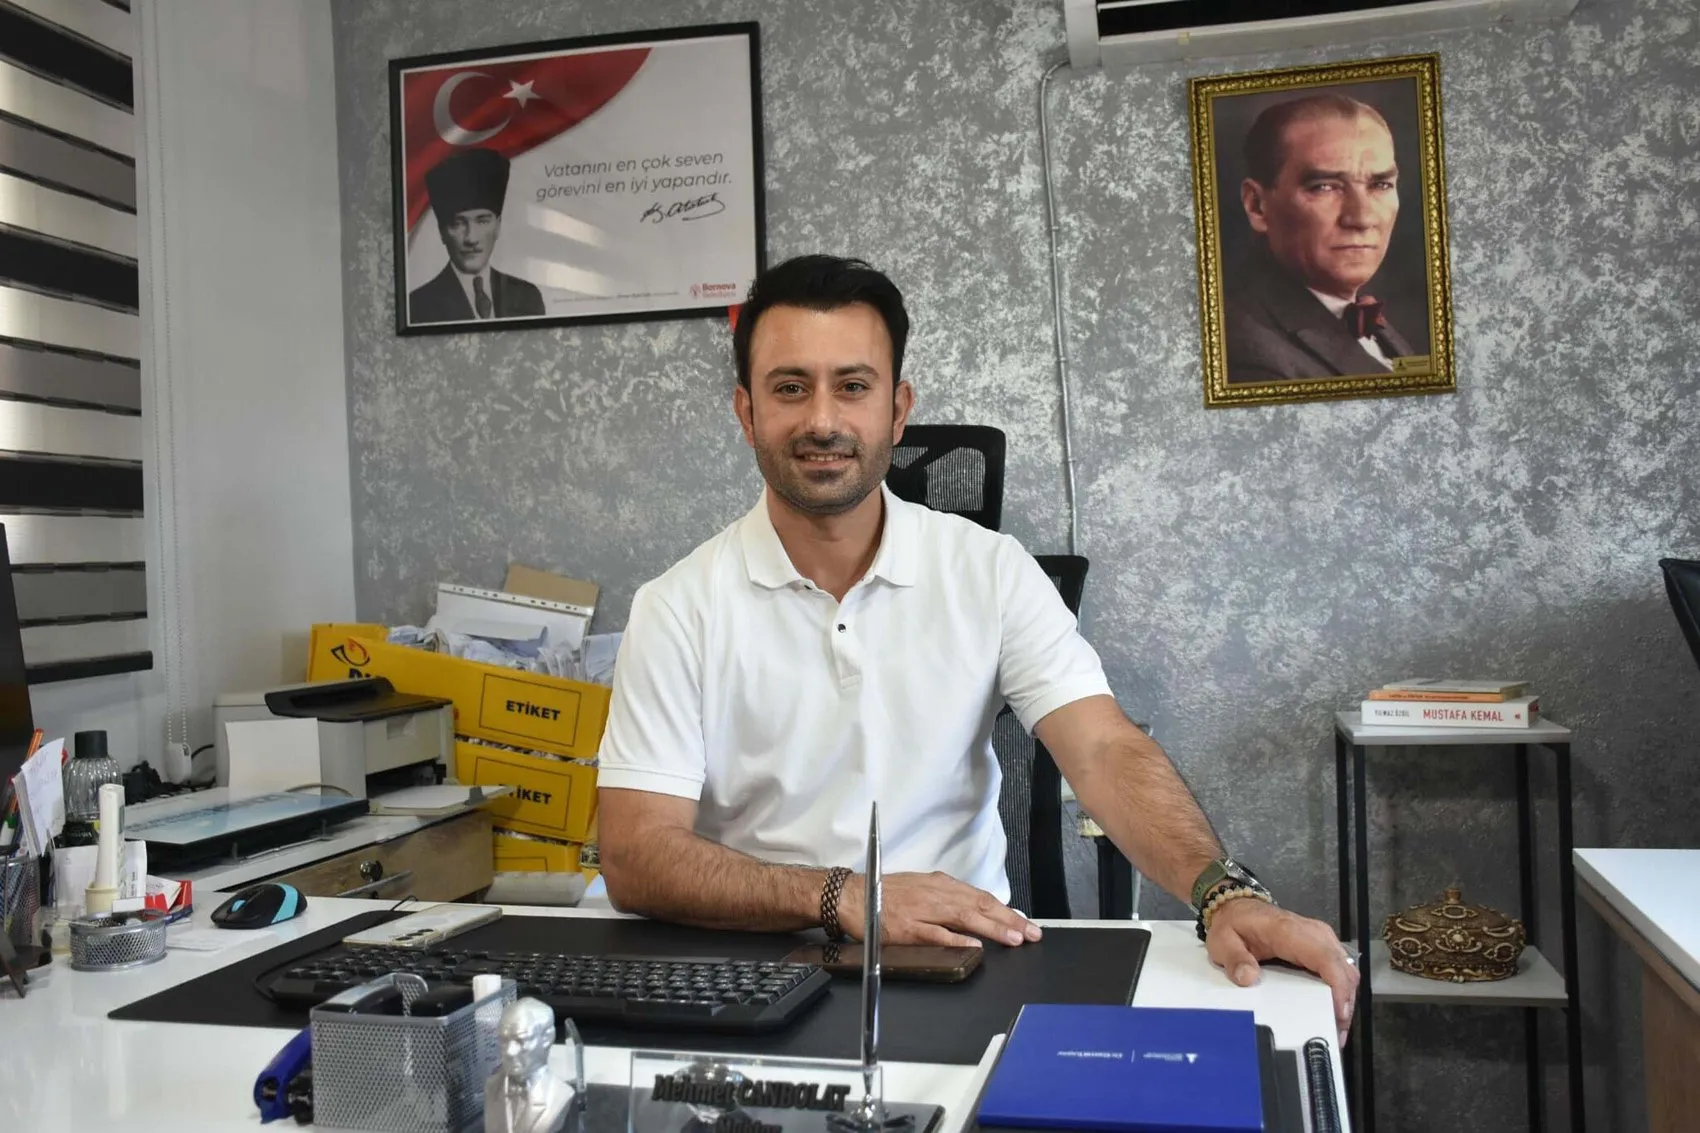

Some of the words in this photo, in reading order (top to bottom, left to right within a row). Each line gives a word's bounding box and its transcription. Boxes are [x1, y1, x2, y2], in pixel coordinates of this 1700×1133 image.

[544, 162, 612, 178] Vatanını
[616, 159, 637, 172] en
[641, 154, 671, 173] çok
[674, 152, 724, 167] seven
[536, 181, 600, 202] görevini
[605, 180, 626, 193] en
[630, 175, 648, 194] iyi
[651, 171, 732, 193] yapandır.
[505, 700, 561, 721] ETİKET
[1423, 709, 1467, 721] MUSTAFA
[1470, 709, 1504, 722] KEMAL
[499, 783, 552, 805] İKET
[652, 1074, 736, 1106] Mehmet
[737, 1079, 851, 1112] CANBOLAT
